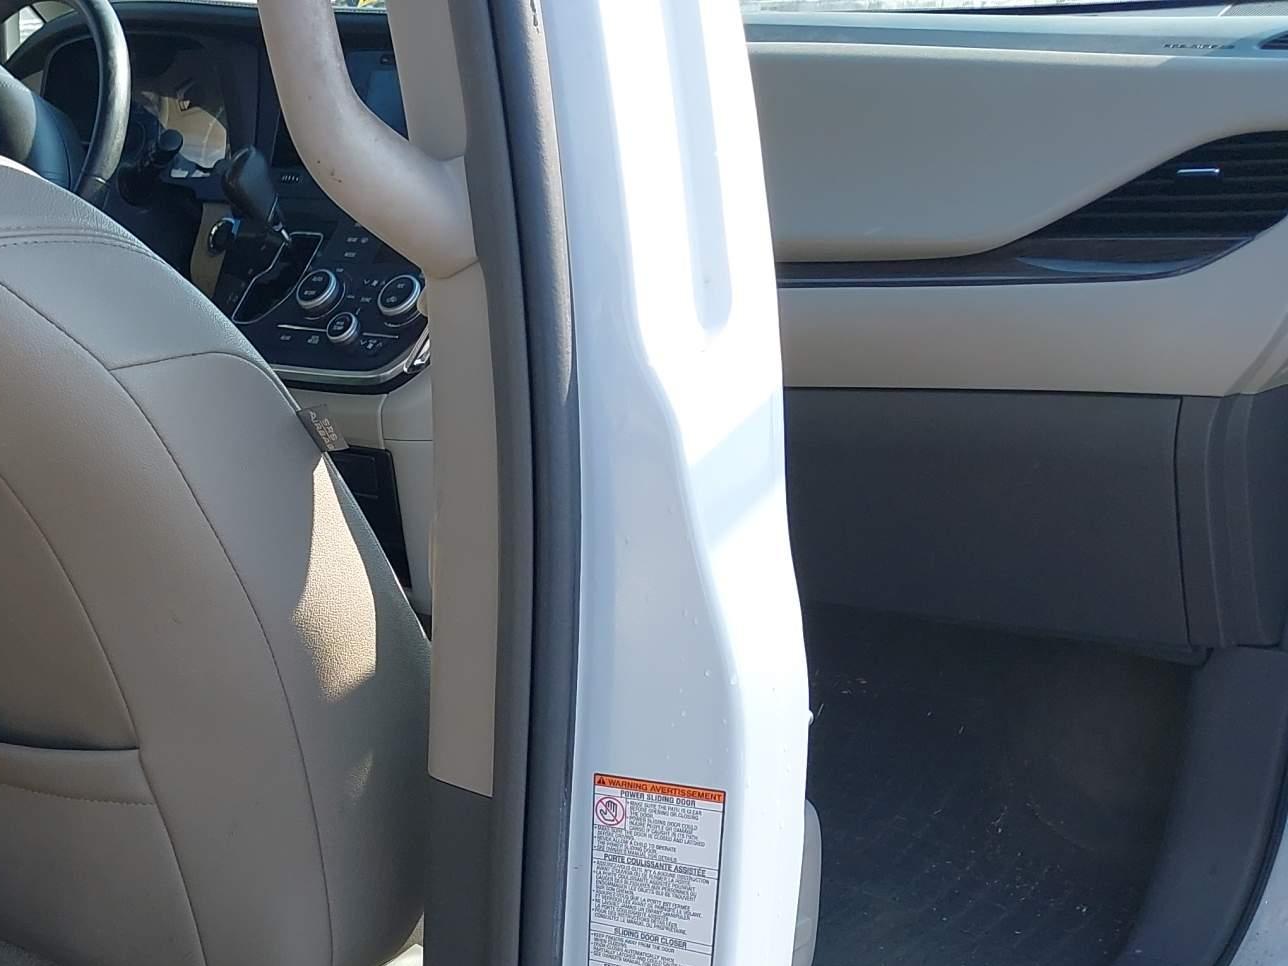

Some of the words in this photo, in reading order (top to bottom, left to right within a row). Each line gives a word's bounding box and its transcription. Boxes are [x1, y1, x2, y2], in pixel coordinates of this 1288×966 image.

[309, 410, 334, 450] AIRBAG
[322, 418, 338, 441] SRS
[608, 778, 647, 790] WARNING
[649, 784, 721, 801] AVERTISSEMENT
[620, 789, 644, 799] POWER
[646, 793, 674, 804] SLIDING
[675, 797, 696, 807] DOOR
[603, 853, 625, 863] PORTE
[626, 857, 672, 871] COULISSANTE
[673, 864, 706, 877] ASSISTÉE
[613, 927, 638, 938] SLIDING
[639, 933, 659, 942] DOOR
[660, 937, 686, 948] CLOSER
